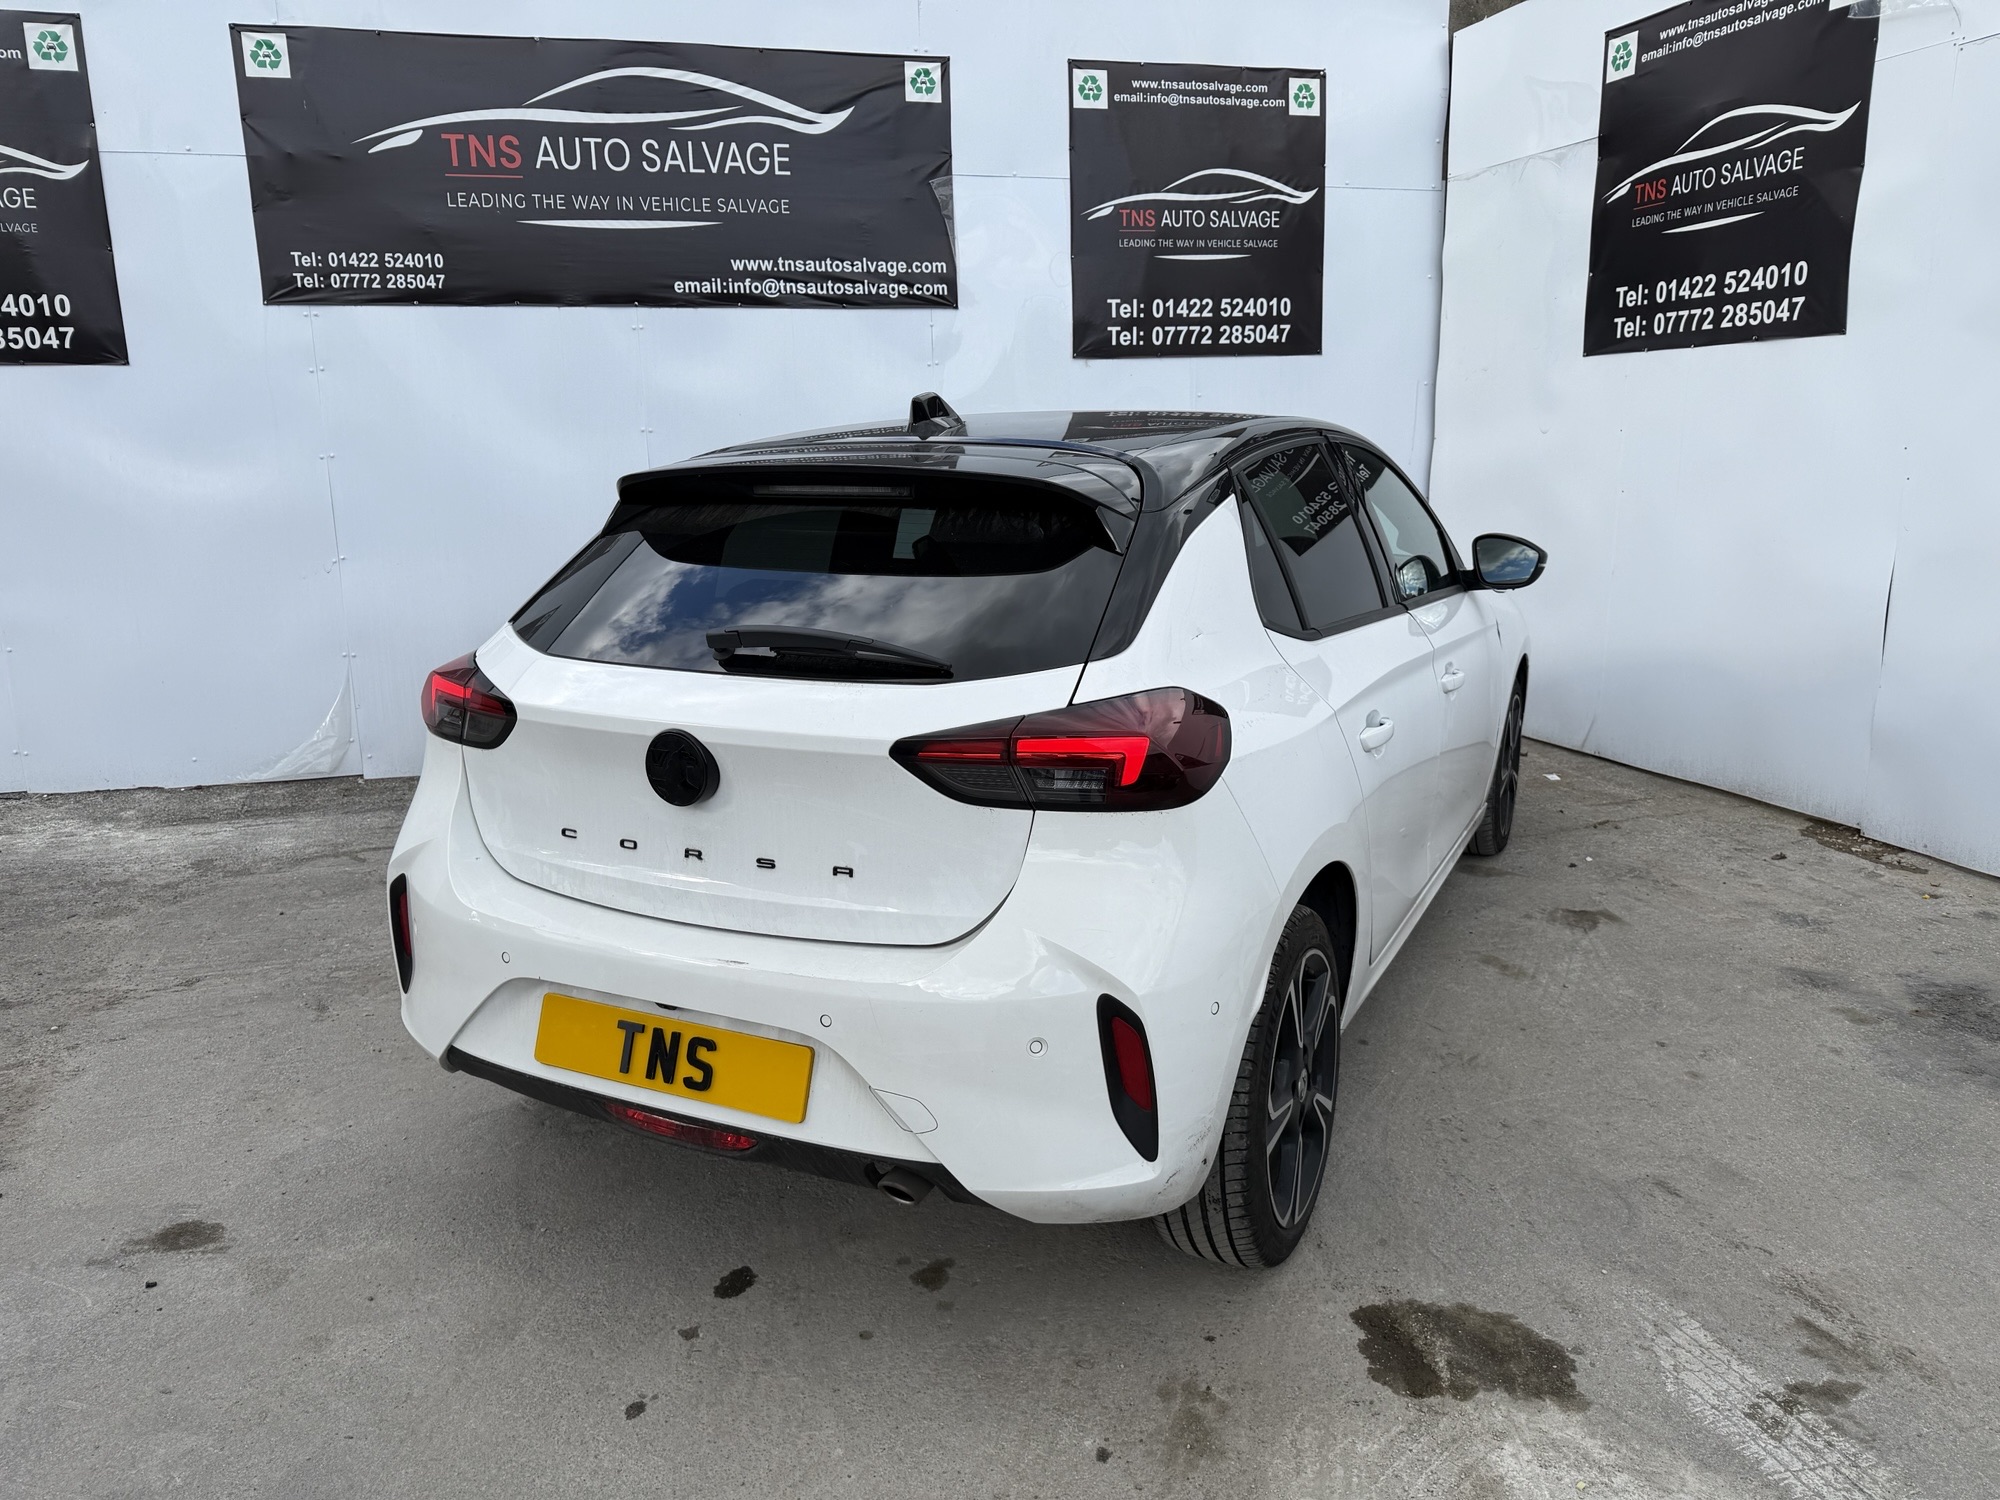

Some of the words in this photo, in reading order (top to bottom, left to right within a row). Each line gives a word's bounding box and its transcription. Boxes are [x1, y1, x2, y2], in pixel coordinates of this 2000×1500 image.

[1659, 0, 1775, 40] www.tnsautosalvag
[1132, 79, 1268, 94] www.tnsautosalvage.com
[1114, 92, 1286, 108] email:info@tnsautosalvage.com
[441, 133, 522, 168] TNS
[535, 136, 630, 172] AUTO
[642, 139, 791, 175] SALVAGE
[1635, 179, 1666, 204] TNS
[1670, 168, 1716, 196] AUTO
[1720, 147, 1805, 186] SALVAGE
[0, 187, 37, 209] GE
[447, 192, 525, 209] LEADING
[532, 194, 566, 209] THE
[571, 195, 610, 211] WAY
[616, 196, 633, 211] IN
[639, 197, 711, 213] VEHICLE
[717, 198, 790, 214] SALVAGE
[1631, 211, 1665, 228] LEADING
[1667, 209, 1682, 220] THE
[1683, 204, 1703, 217] WAY
[1704, 203, 1714, 213] IN
[1716, 195, 1754, 211] VEHICLE
[1756, 186, 1799, 203] SALVAGE
[0, 222, 39, 233] LVAGE
[1119, 209, 1156, 227] TNS
[1161, 210, 1205, 228] AUTO
[1209, 210, 1280, 228] SALVAGE
[1119, 239, 1156, 248] LEADING
[1158, 239, 1174, 248] THE
[1176, 239, 1194, 248] WAY
[1196, 239, 1205, 248] IN
[1207, 239, 1241, 248] VEHICLE
[1243, 239, 1278, 248] SALVAGE
[290, 252, 322, 267] Tel:
[328, 252, 379, 268] 01422
[384, 253, 444, 268] 524010
[731, 257, 947, 277] www.tnsautosalvage.com
[293, 272, 324, 289] Tel:
[330, 273, 381, 289] 07772
[386, 274, 445, 289] 285047
[673, 278, 948, 298] email:info@tnsautosalvage.com
[1616, 284, 1648, 308] Tel:
[1656, 273, 1716, 304] 01422
[1723, 260, 1808, 295] 524010
[0, 293, 71, 317] 4010
[1107, 299, 1144, 318] Tel:
[1152, 298, 1213, 318] 01422
[1220, 297, 1291, 317] 524010
[1614, 316, 1646, 339] Tel:
[1653, 307, 1713, 335] 07772
[1720, 296, 1805, 329] 285047
[1107, 326, 1144, 346] Tel:
[1152, 325, 1212, 345] 07772
[1219, 324, 1291, 344] 285047
[617, 1019, 717, 1092] TNS
